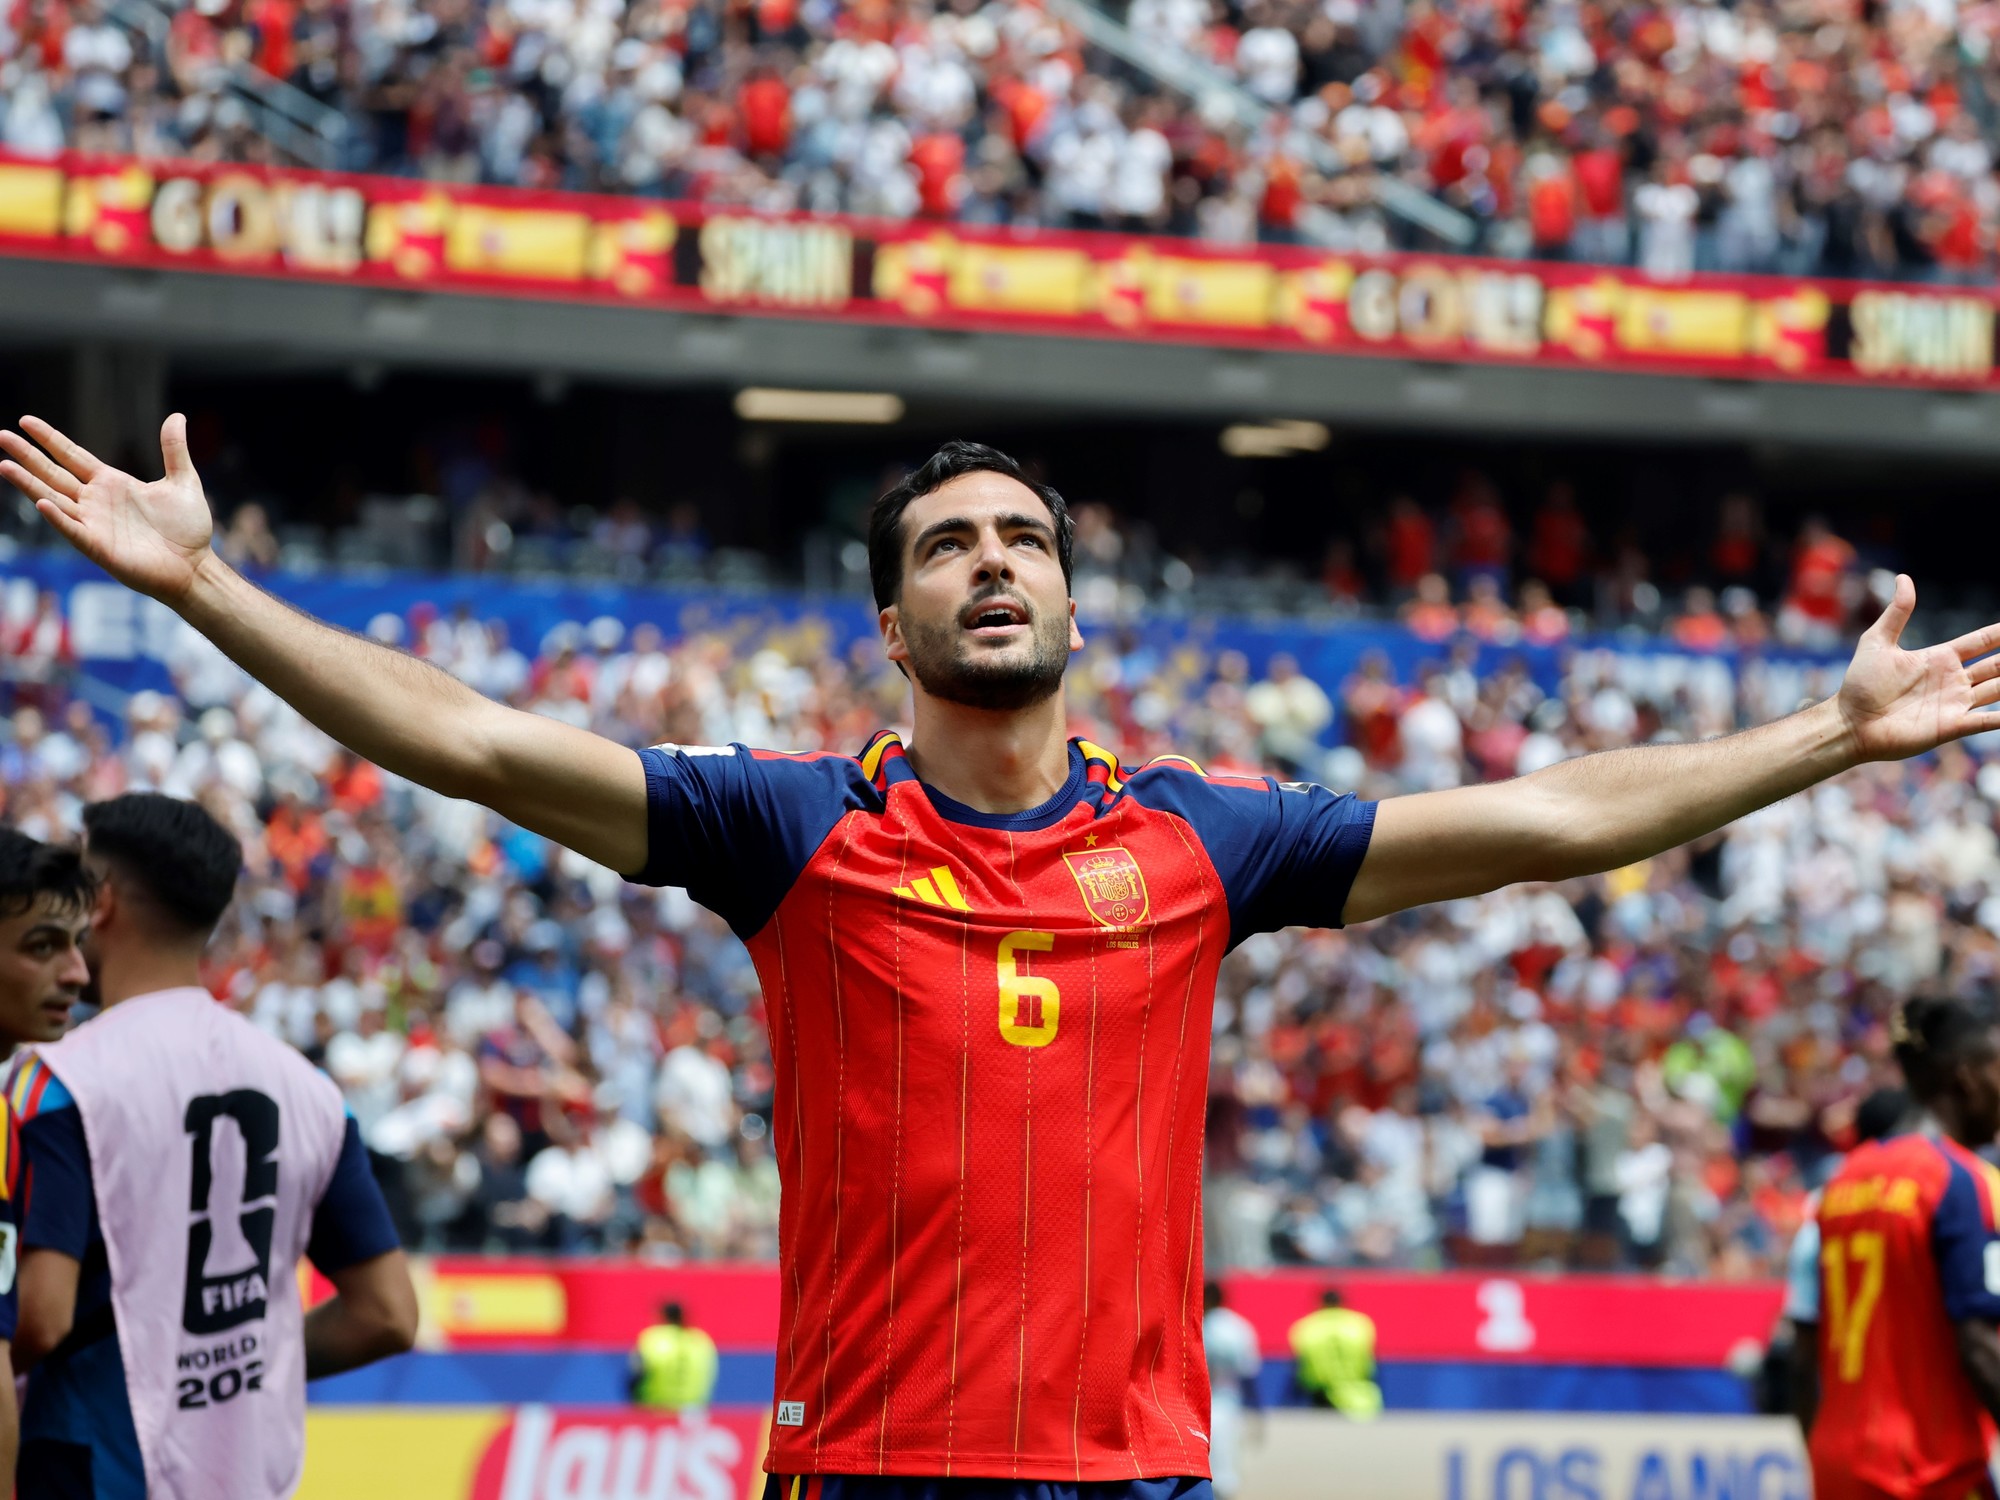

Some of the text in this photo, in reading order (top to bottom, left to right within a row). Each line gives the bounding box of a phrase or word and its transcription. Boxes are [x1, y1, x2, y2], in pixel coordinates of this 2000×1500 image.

[701, 216, 850, 306] SPAIN
[1851, 289, 1993, 379] SPAIN
[998, 931, 1060, 1047] 6
[202, 1273, 268, 1315] FIFA
[1823, 1232, 1884, 1382] 17
[177, 1334, 257, 1370] WORLD
[177, 1361, 263, 1410] 202
[1634, 1447, 1803, 1500] ANG
